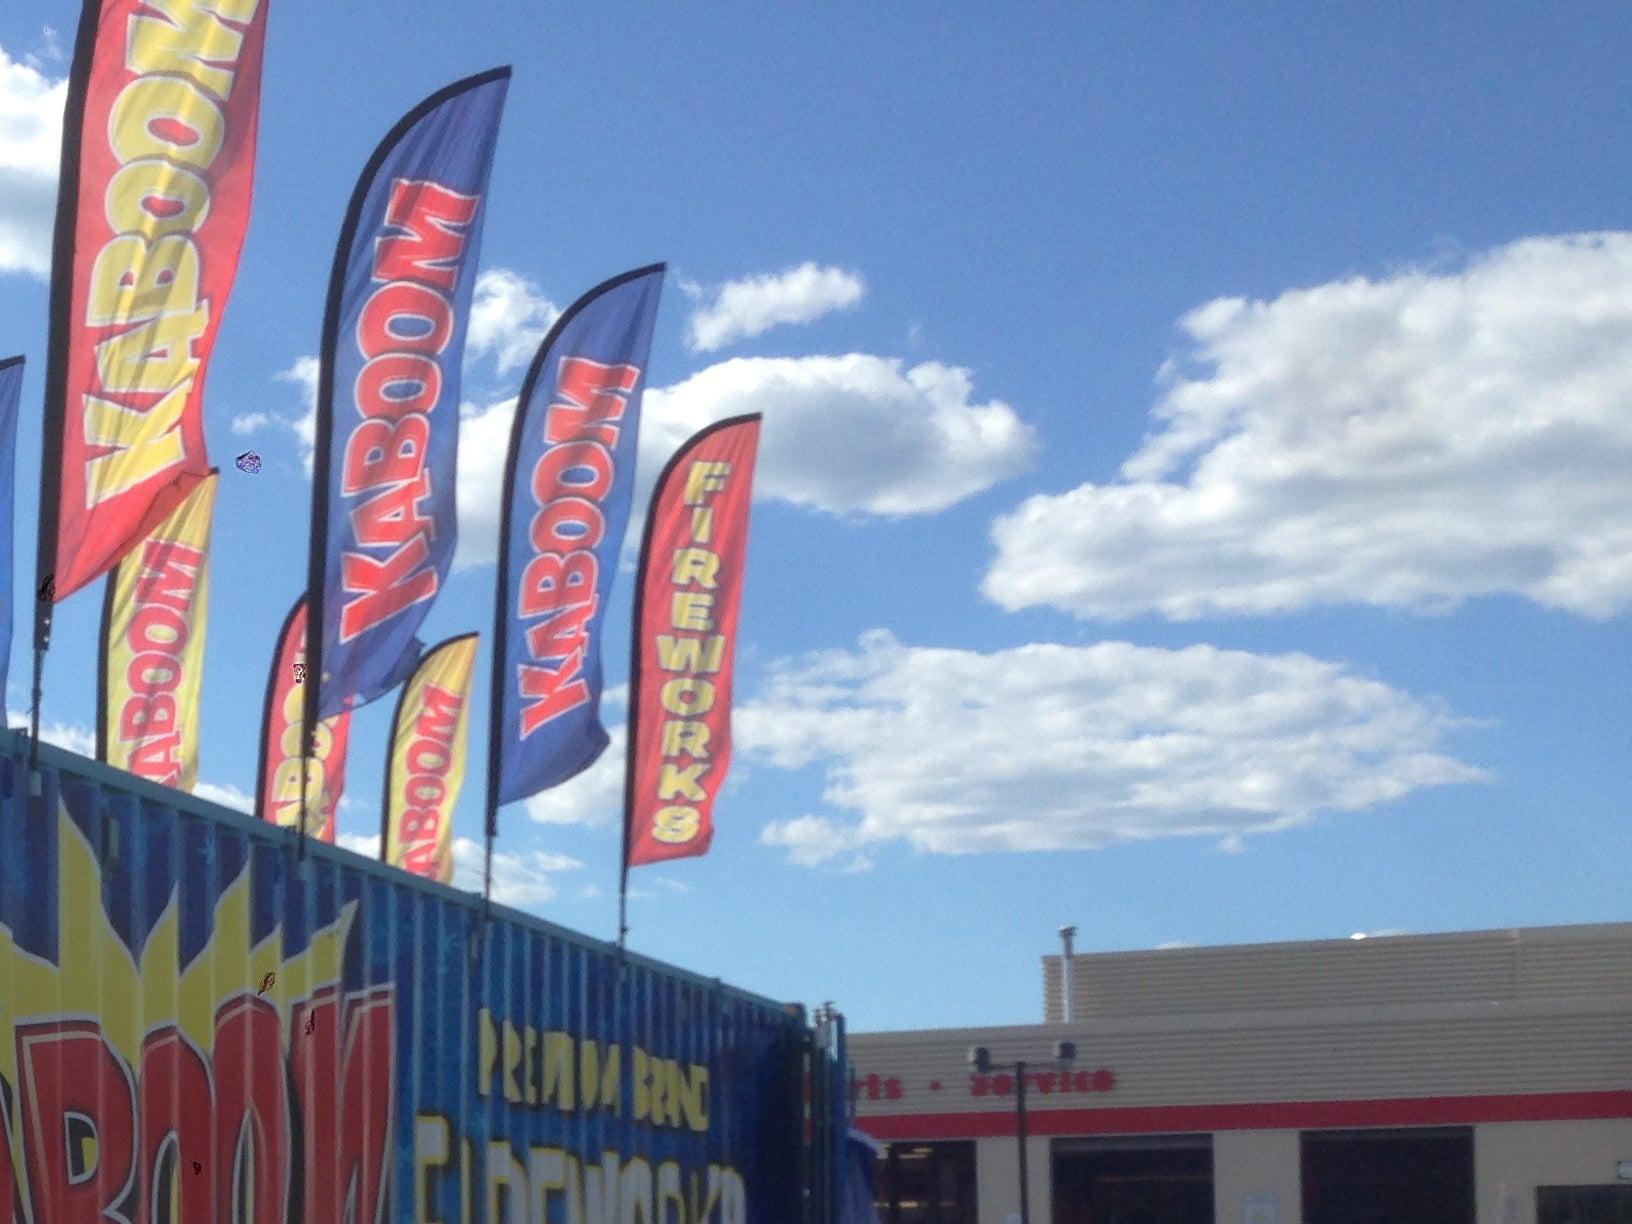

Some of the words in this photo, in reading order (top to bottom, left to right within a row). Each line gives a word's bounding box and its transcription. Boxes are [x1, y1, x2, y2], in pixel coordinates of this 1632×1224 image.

[340, 177, 479, 644] KABOOM
[517, 356, 640, 741] KABOOM
[650, 461, 731, 844] FIREWORKS
